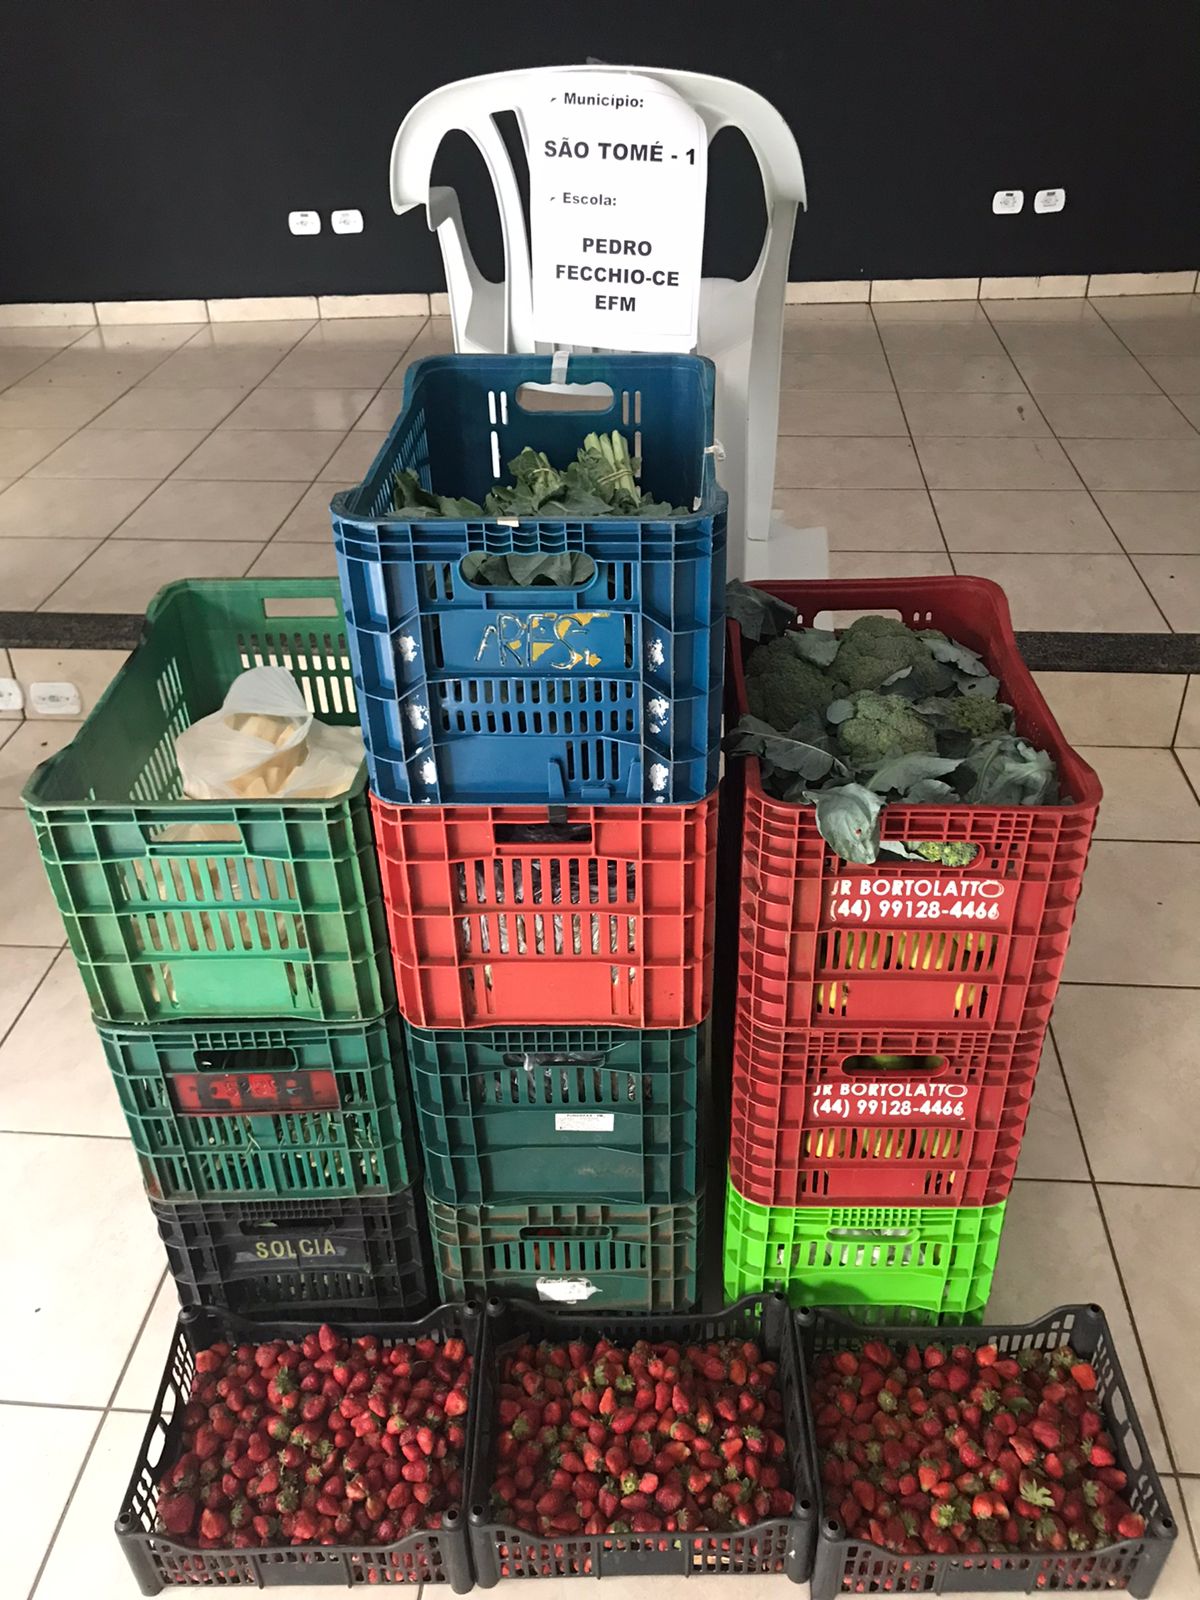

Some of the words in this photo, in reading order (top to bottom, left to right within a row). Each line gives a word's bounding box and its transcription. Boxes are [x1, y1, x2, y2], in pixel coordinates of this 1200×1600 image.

[545, 137, 590, 159] SÃO
[597, 141, 664, 163] TOMÉ
[685, 148, 695, 166] 1
[563, 192, 617, 206] Escola:
[582, 237, 653, 257] PEDRO
[555, 264, 680, 287] FECCHIO-CE
[594, 294, 636, 312] EFM
[831, 879, 852, 896] JR
[859, 879, 1005, 898] BORTOLATTO
[830, 899, 871, 922] (44)
[878, 900, 1000, 920] 99128-4466
[812, 1083, 833, 1097] JR
[839, 1083, 968, 1098] BORTOLATTO
[812, 1098, 850, 1118] (44)
[856, 1100, 964, 1116] 99128-4466
[255, 1238, 337, 1259] SOLCIA
